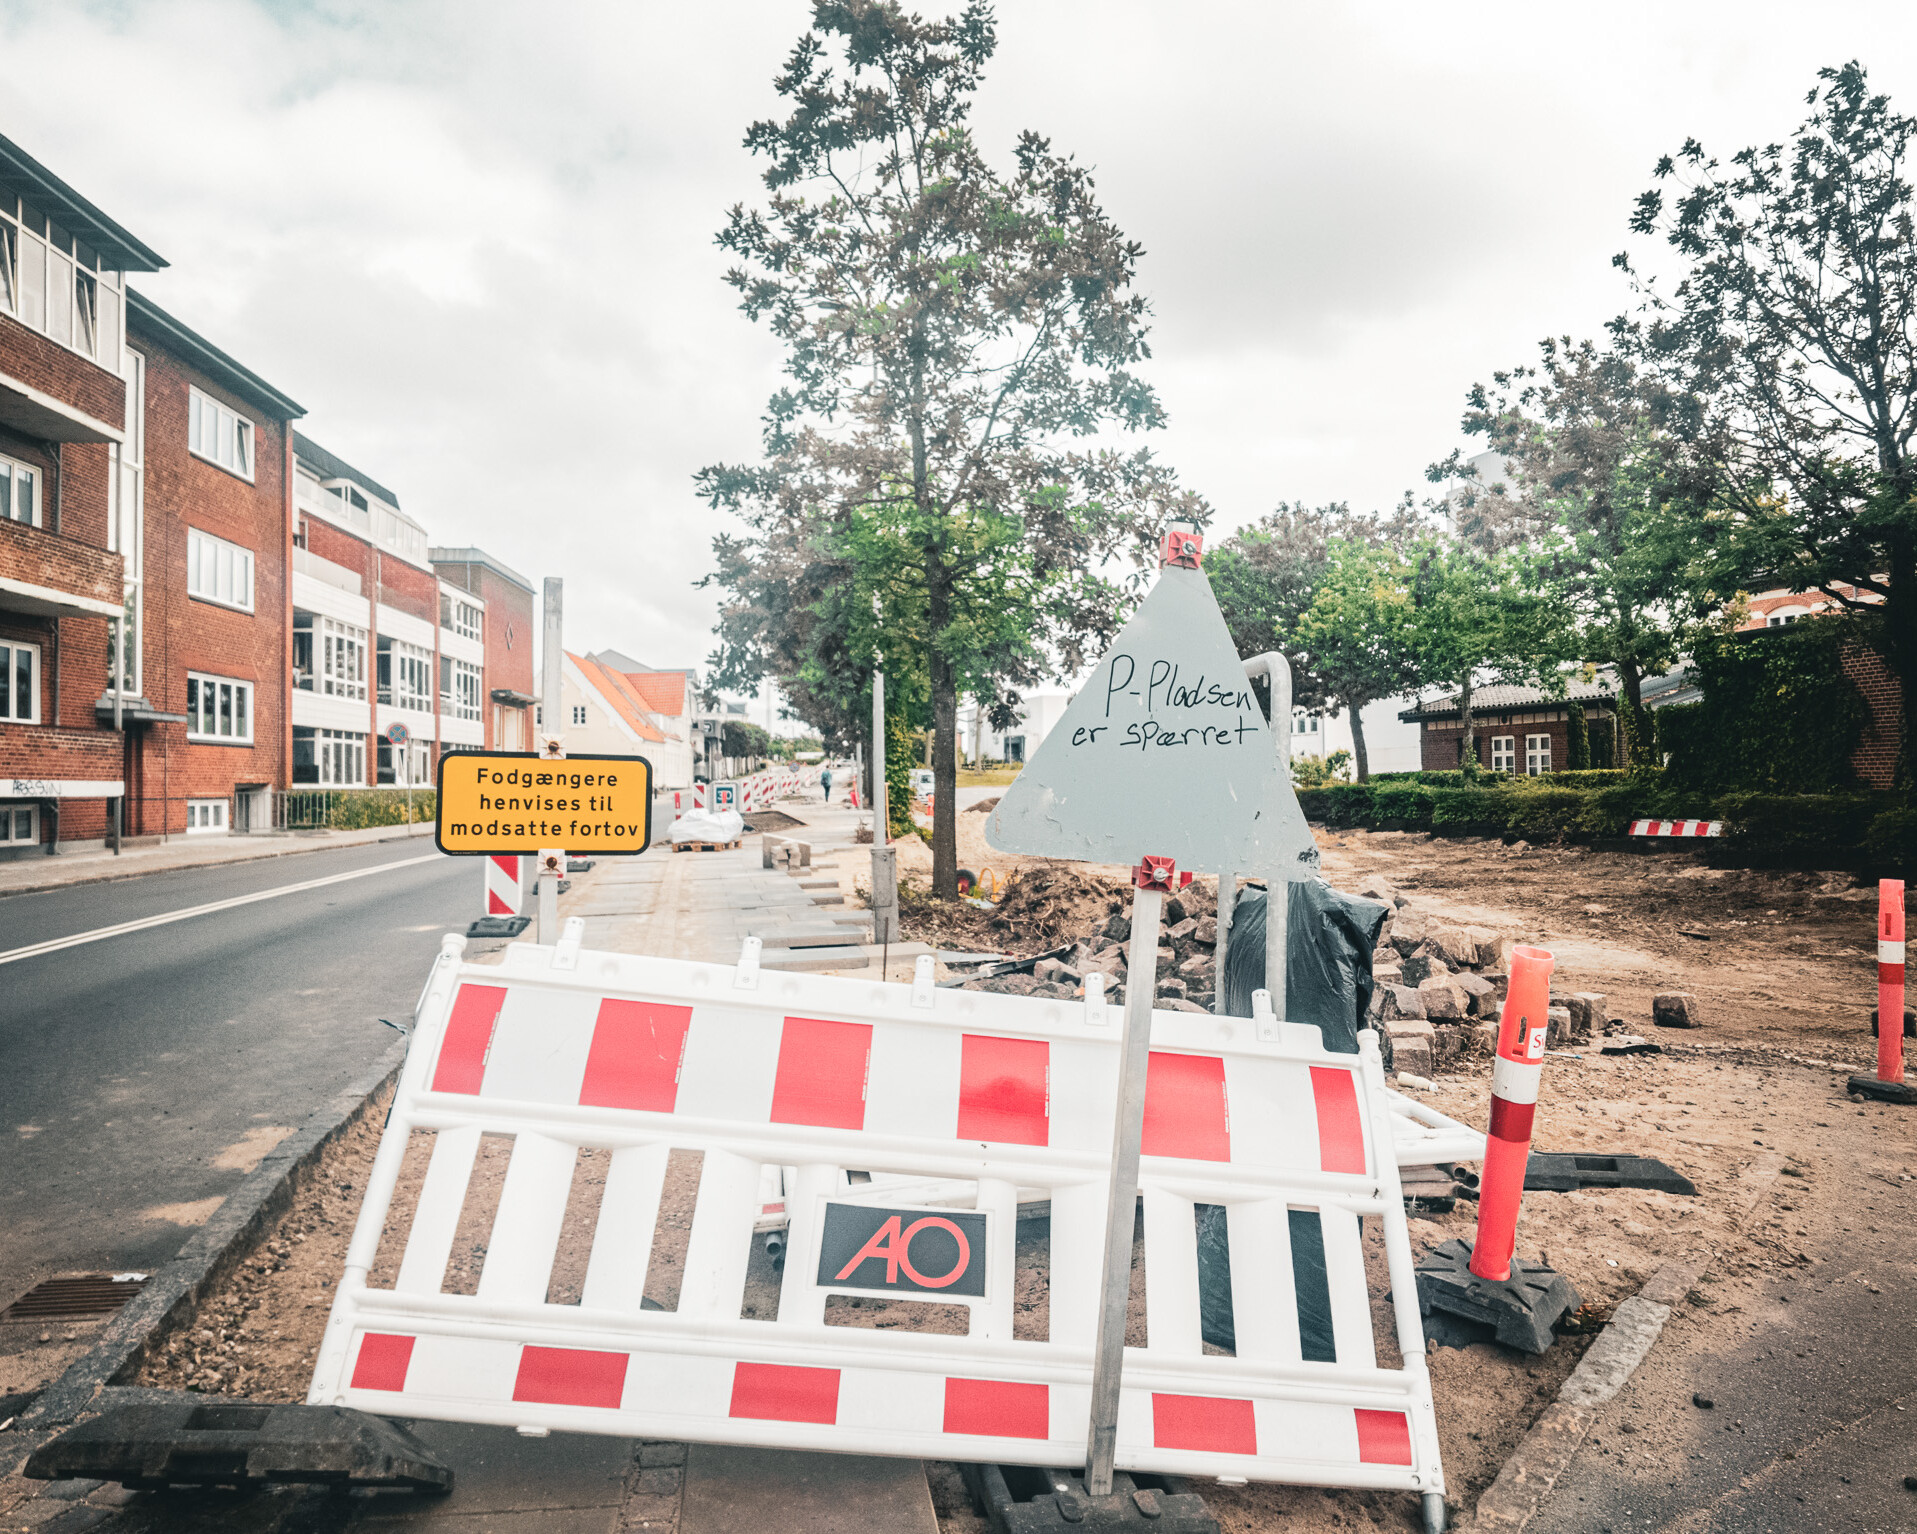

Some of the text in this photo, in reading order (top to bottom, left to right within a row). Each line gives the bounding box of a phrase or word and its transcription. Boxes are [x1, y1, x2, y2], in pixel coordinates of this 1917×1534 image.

[1105, 654, 1252, 717] P-Pladsen
[1072, 715, 1259, 751] er spærret
[476, 767, 618, 789] Fodgængere
[479, 793, 613, 812] henvises til
[450, 819, 639, 837] modsatte fortov
[834, 1215, 971, 1289] AO
